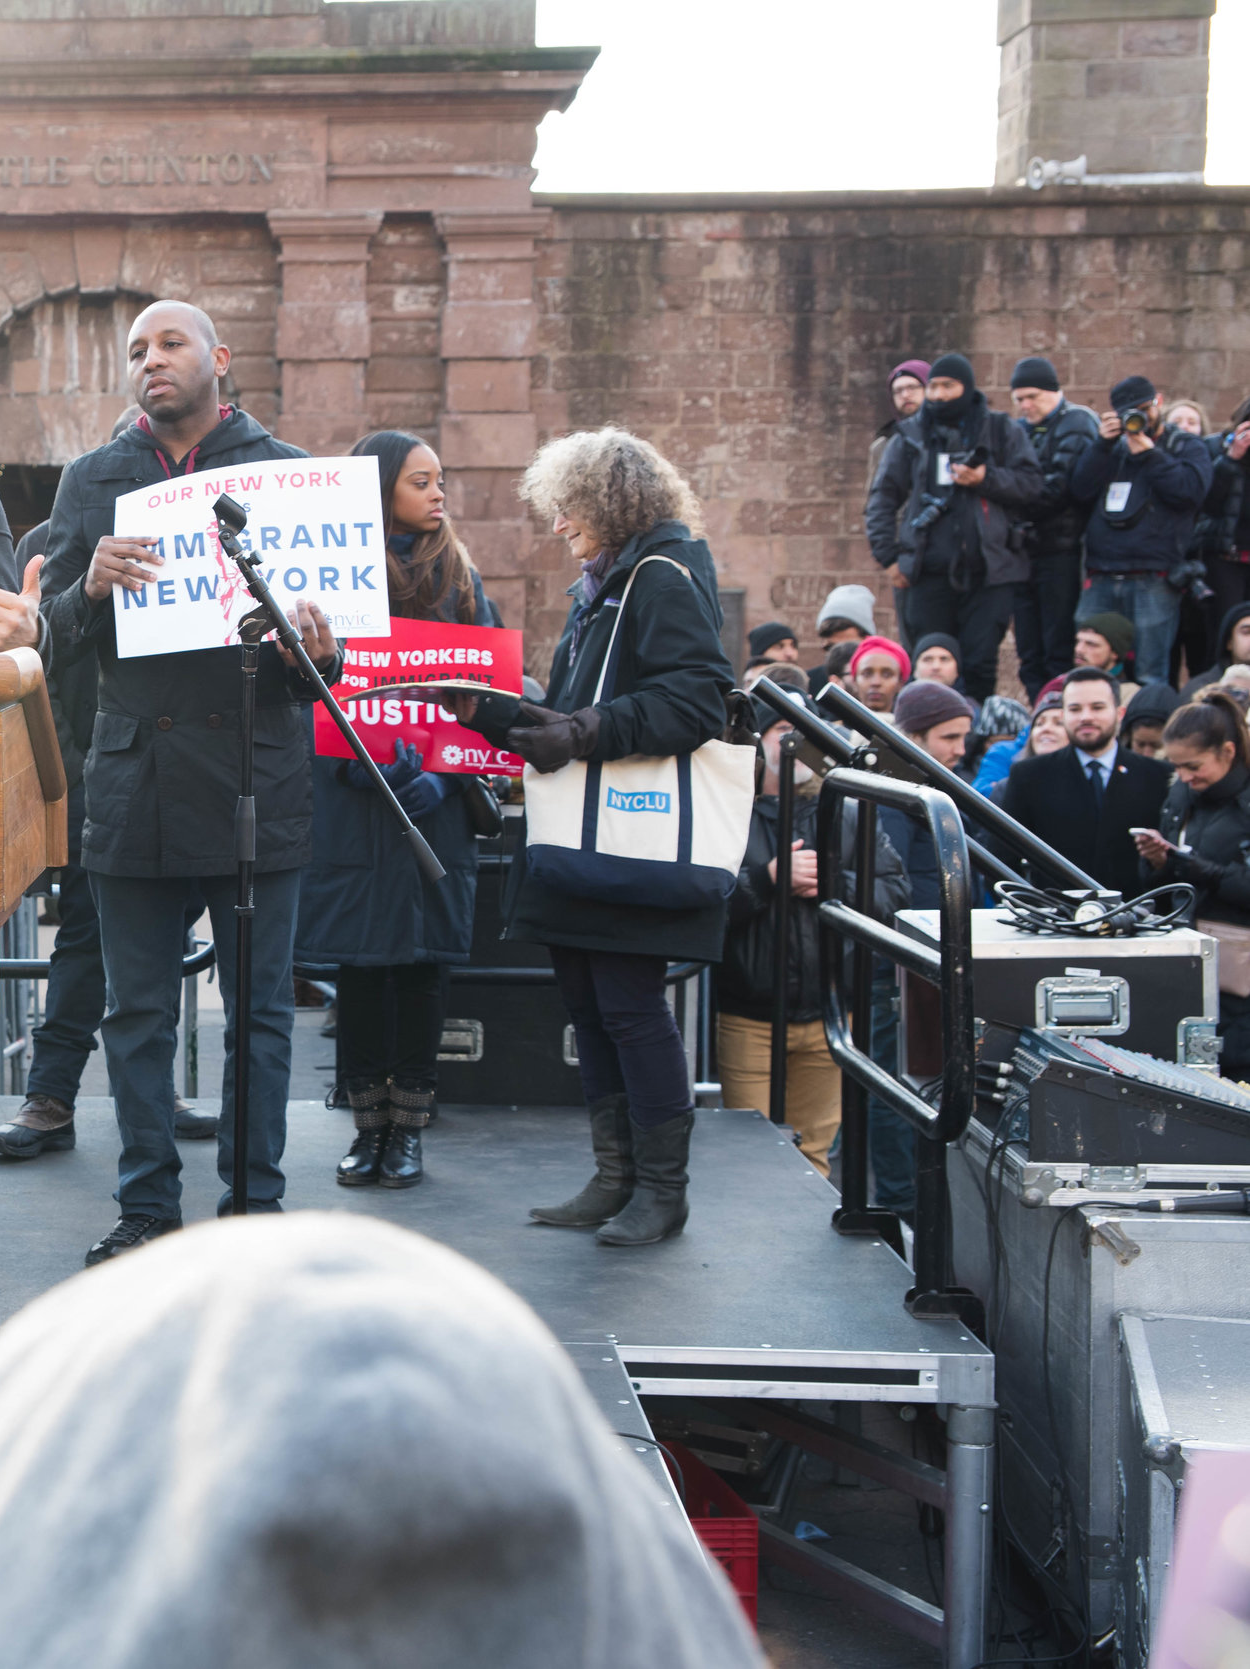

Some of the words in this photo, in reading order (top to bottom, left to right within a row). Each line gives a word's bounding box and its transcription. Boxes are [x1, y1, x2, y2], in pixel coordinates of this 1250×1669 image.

[93, 152, 276, 186] CLINTON
[147, 486, 195, 509] OUR
[205, 475, 263, 496] NEW
[274, 471, 342, 489] YORK
[122, 573, 220, 610] NEW
[343, 649, 392, 668] NEW
[398, 648, 494, 667] YORKERS
[341, 674, 369, 688] FOR
[343, 700, 458, 726] JUSTIC
[464, 748, 510, 770] nyic
[611, 791, 666, 810] NYCLU
